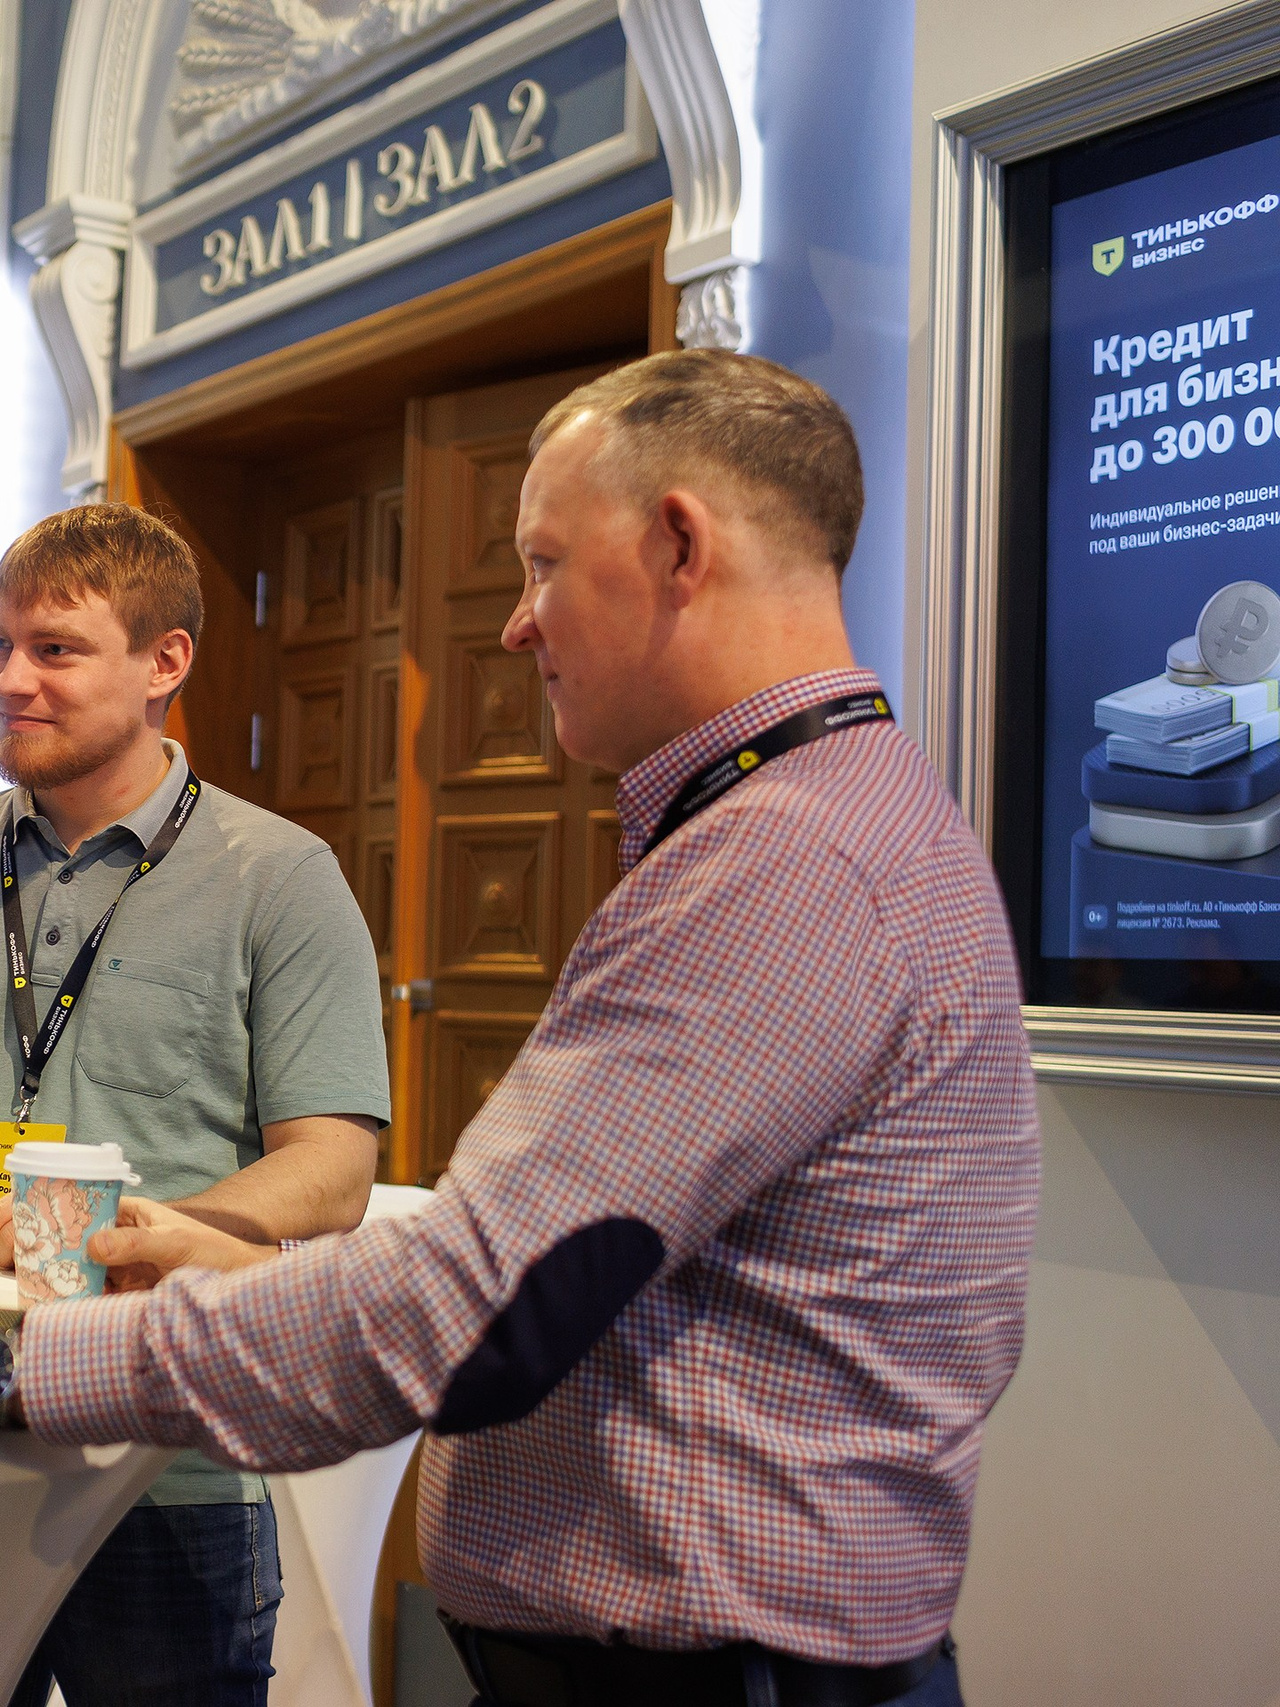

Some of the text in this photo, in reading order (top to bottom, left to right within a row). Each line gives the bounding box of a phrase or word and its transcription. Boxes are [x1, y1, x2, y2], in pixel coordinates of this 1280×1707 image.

[1131, 193, 1280, 249] ТИНЬКОФФ
[1132, 237, 1206, 269] БИЗНЕС
[1093, 309, 1254, 378] Кредит
[1090, 381, 1168, 433] для
[1090, 405, 1280, 484] до 300 0
[1089, 495, 1221, 531] Индивидуальное
[1089, 537, 1117, 555] под
[1120, 530, 1160, 550] ваши
[9, 932, 19, 977] ТИНЬКОФФ
[43, 1009, 68, 1055] ТИНЬКОФФ
